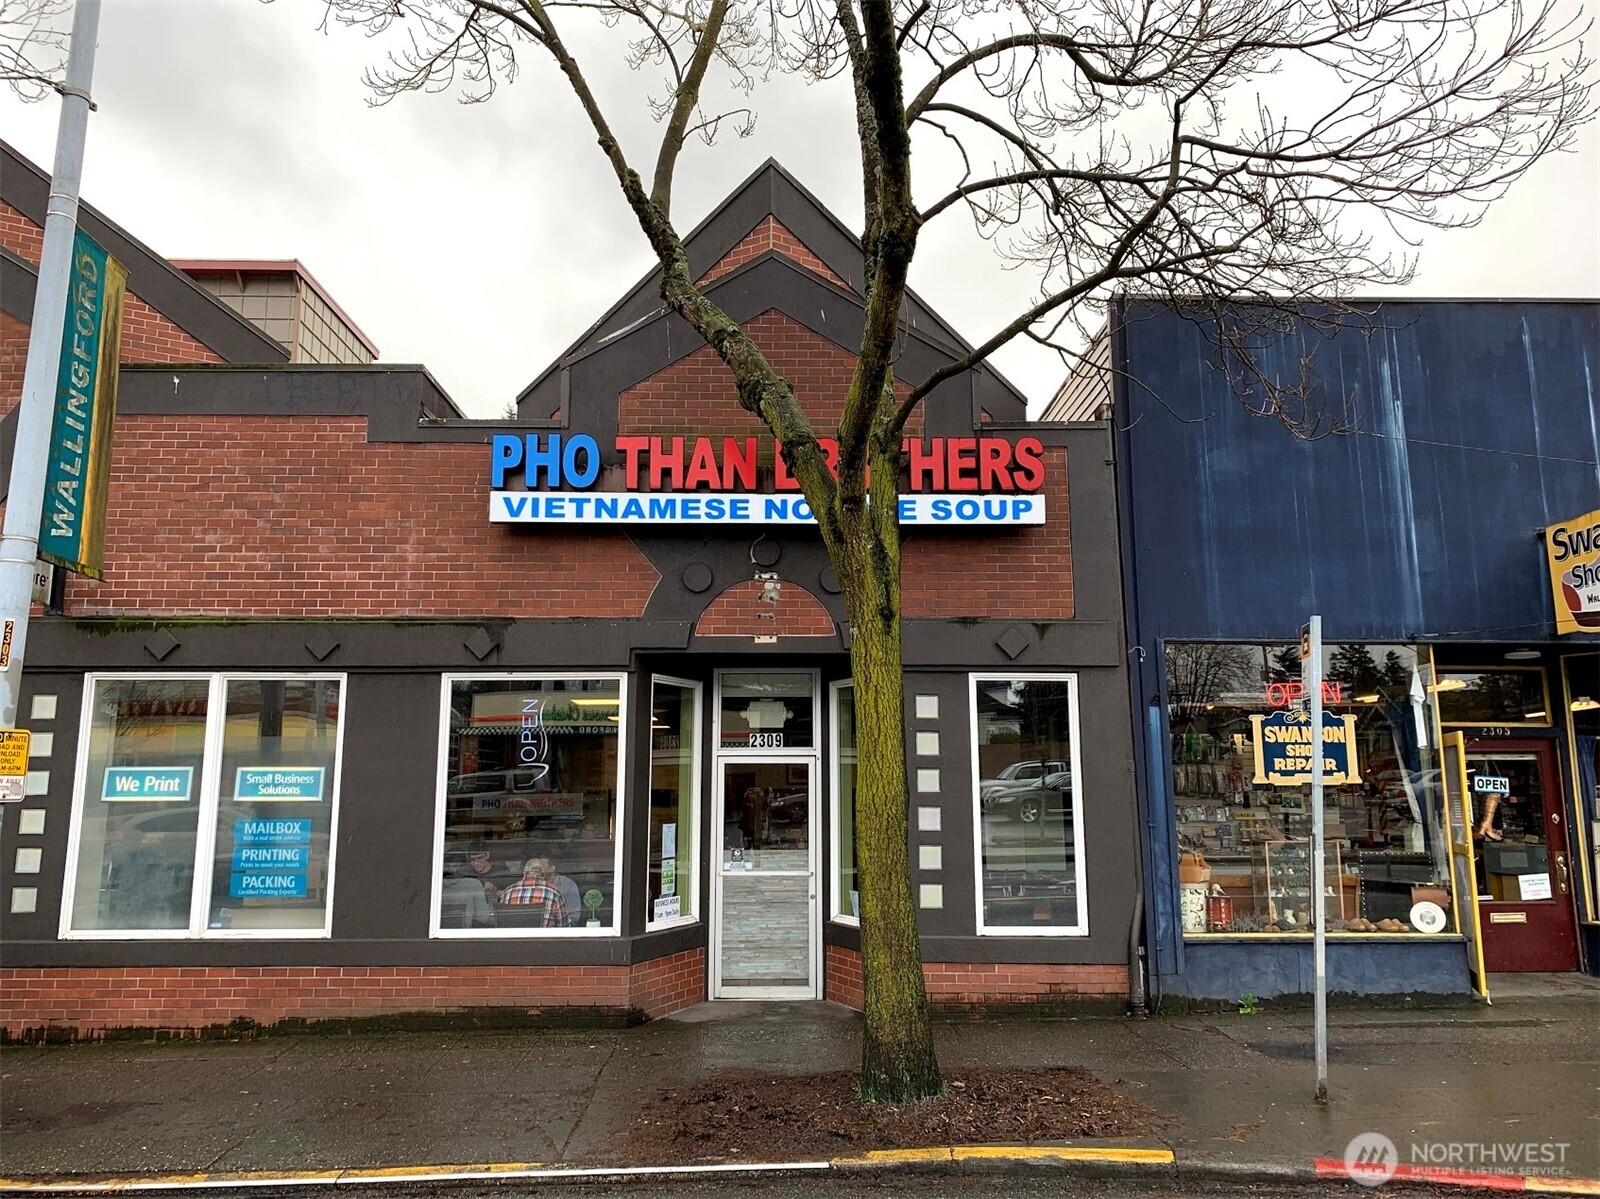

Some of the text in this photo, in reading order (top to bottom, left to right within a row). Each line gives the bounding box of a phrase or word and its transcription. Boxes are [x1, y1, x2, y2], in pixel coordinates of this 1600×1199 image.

[50, 252, 99, 538] WALLINGFORD
[491, 433, 601, 489] PHO
[615, 436, 758, 491] THAN
[503, 496, 1034, 521] VIETNAMESE NOE SOUP
[0, 621, 13, 666] 2303
[1267, 681, 1343, 707] OPN
[520, 699, 539, 762] OPEN
[1264, 726, 1346, 743] SWANON
[1482, 727, 1511, 736] 2305
[5, 735, 28, 743] MINUTE
[750, 734, 783, 748] 2309
[1285, 744, 1324, 757] SHO
[115, 776, 181, 792] We Print
[246, 773, 315, 784] Small Business
[1476, 778, 1508, 790] OPEN
[257, 784, 301, 795] Solutions
[481, 799, 501, 809] PHO
[243, 822, 302, 834] MAILBOX
[241, 849, 300, 861] PRINTING
[242, 875, 296, 888] PACKING
[259, 889, 279, 897] Packing
